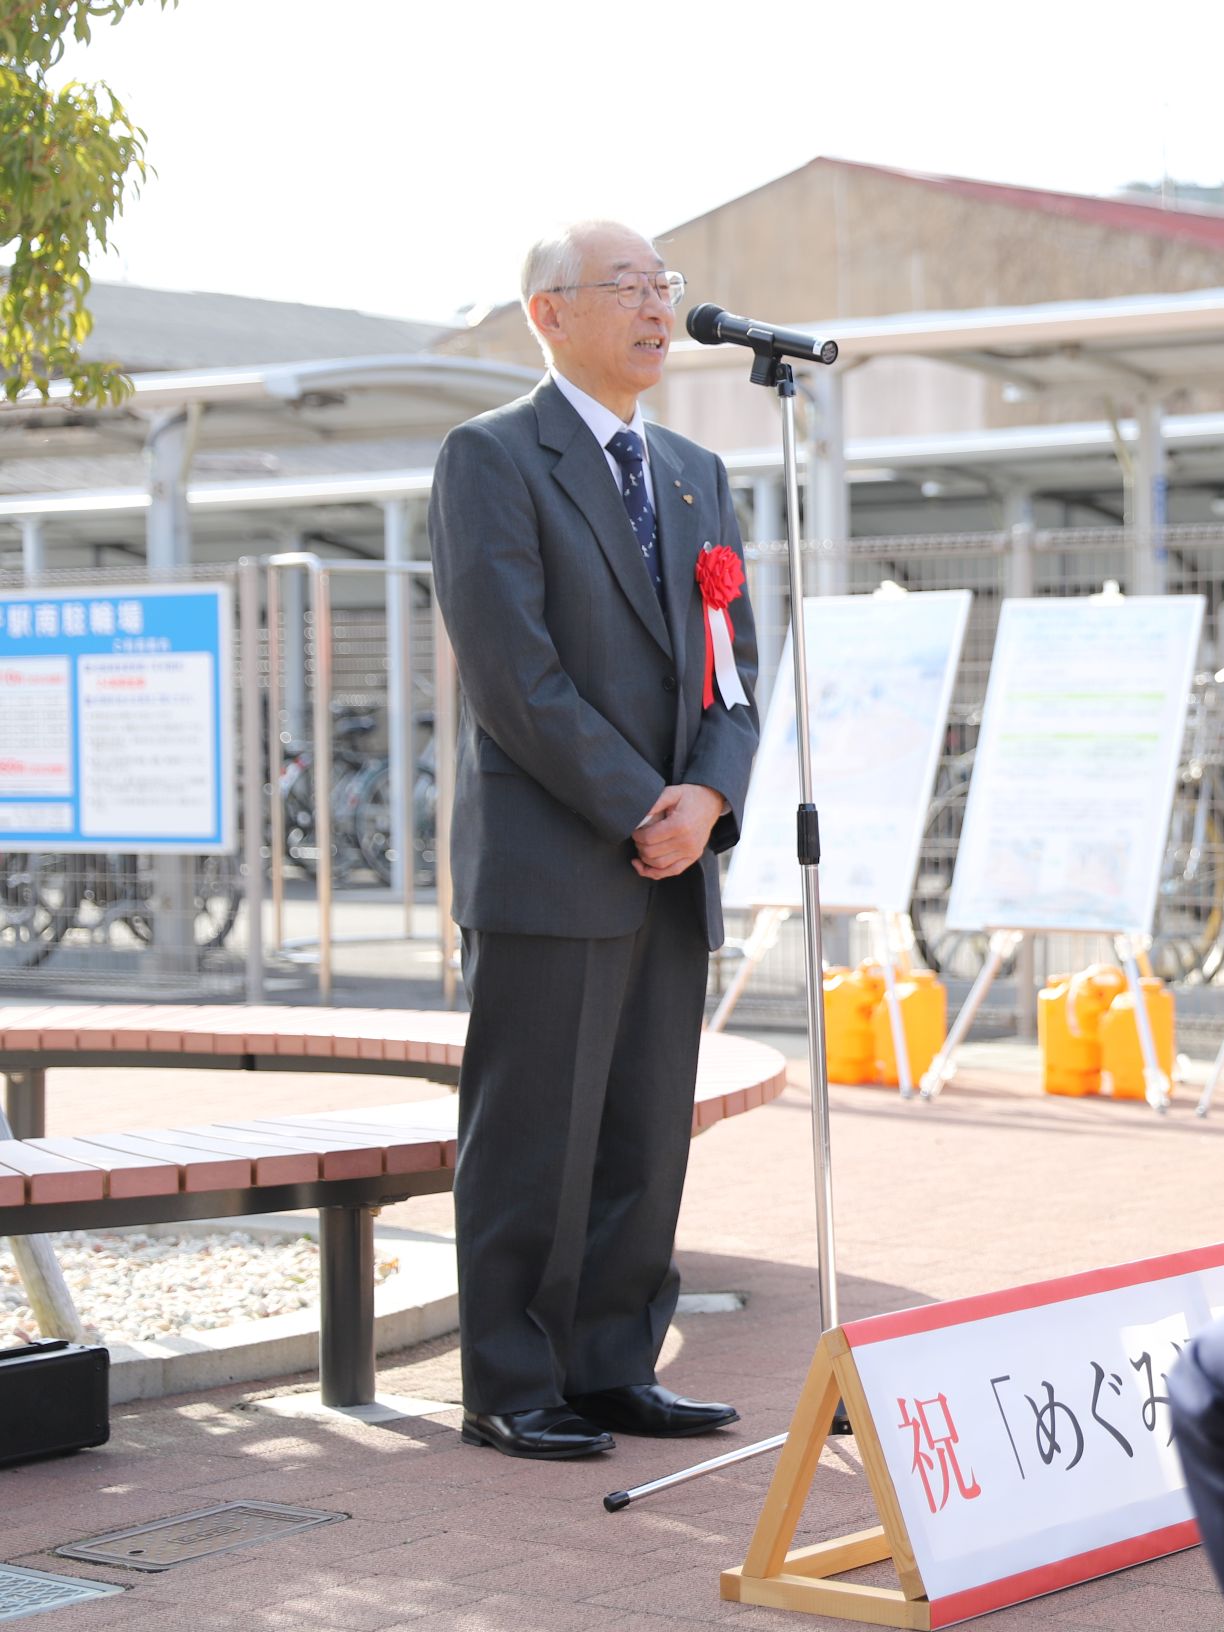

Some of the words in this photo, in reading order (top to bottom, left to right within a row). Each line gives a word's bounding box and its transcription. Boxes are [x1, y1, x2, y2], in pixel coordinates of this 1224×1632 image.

[896, 1392, 982, 1514] 祝
[990, 1338, 1190, 1480] 「めぐみ
